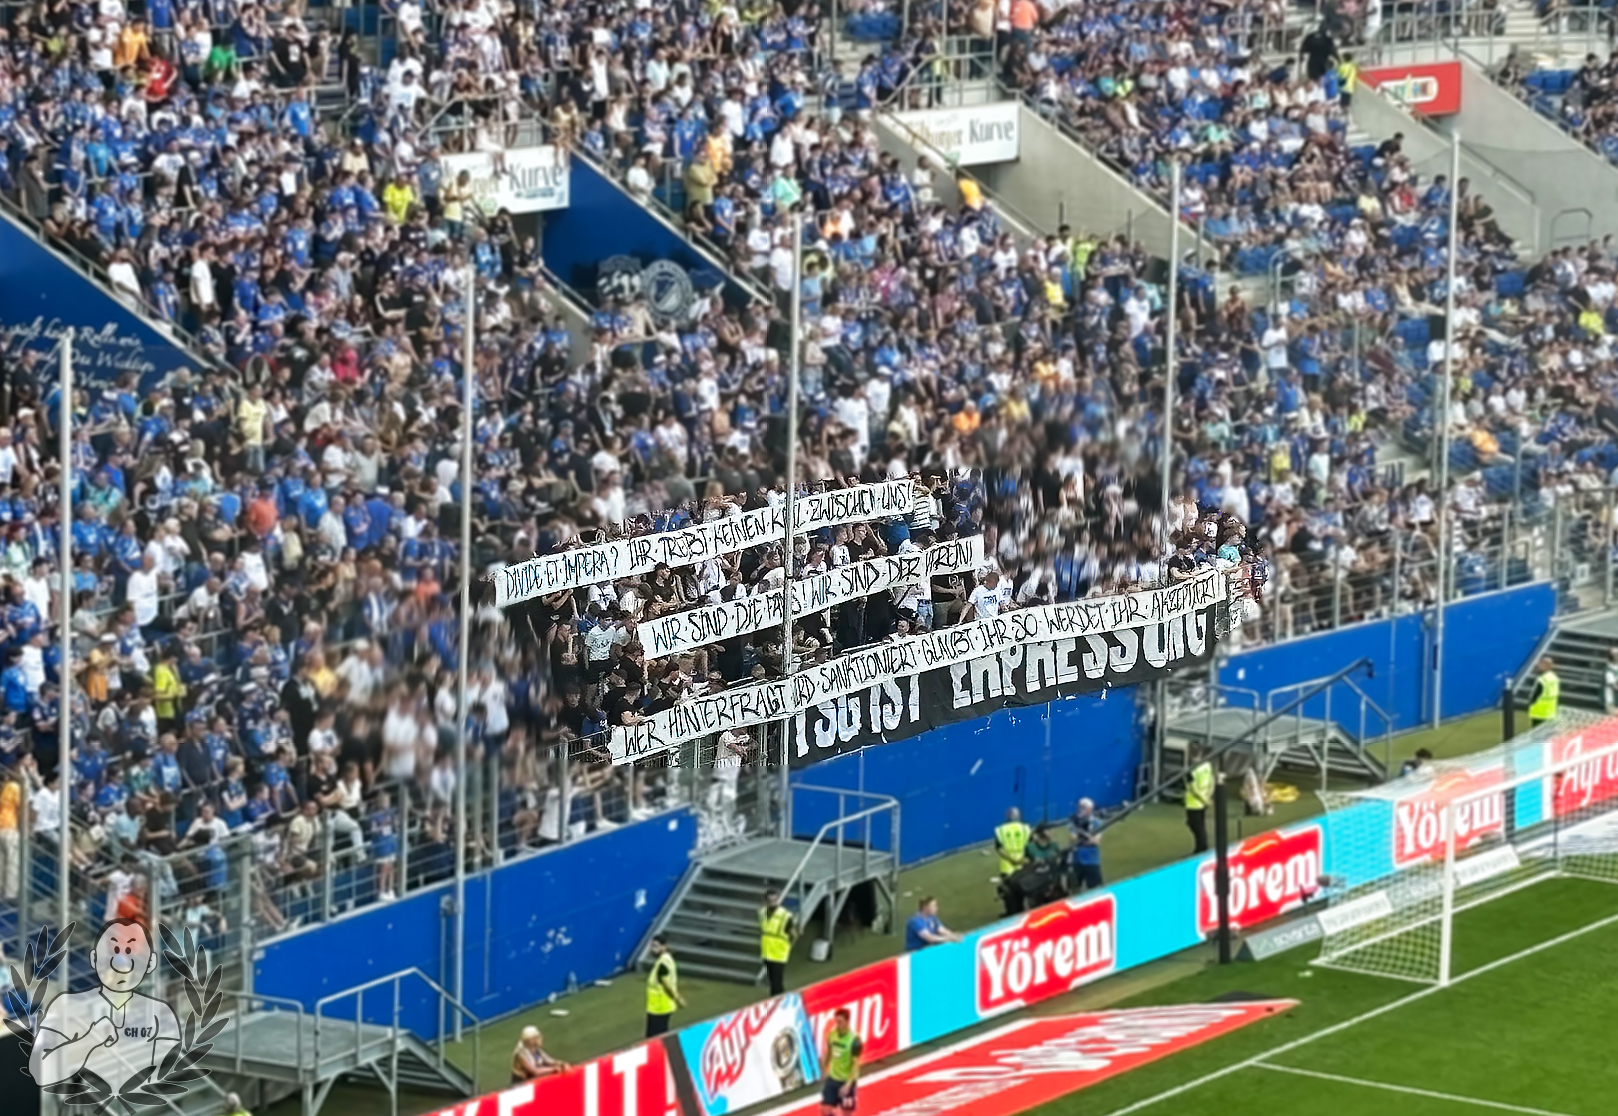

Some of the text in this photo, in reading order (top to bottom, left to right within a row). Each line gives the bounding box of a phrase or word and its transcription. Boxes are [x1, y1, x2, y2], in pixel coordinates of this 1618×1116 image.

[505, 563, 543, 600] DIVIDE
[546, 560, 559, 588] ET
[562, 546, 619, 585] IMPERA?
[627, 539, 656, 571] IHR
[714, 511, 766, 554] KEINEN
[809, 488, 875, 521] ZWISCHEN
[882, 481, 911, 511] UNS!
[652, 616, 686, 654] WIR
[688, 606, 728, 642] SIND
[734, 599, 763, 633] DIE
[766, 584, 808, 620] FAS!
[811, 574, 837, 609] WIR
[841, 562, 879, 596] SIND
[886, 556, 920, 584] DER
[623, 718, 665, 756] WER
[668, 684, 786, 738] HINTERFRAGT
[820, 641, 918, 693] SANKTIONIERT
[922, 627, 975, 666] GLAUBT
[977, 618, 1011, 652] IHR
[1012, 613, 1037, 642] SO
[1043, 602, 1106, 635] WERDET
[1111, 592, 1148, 629] IHR
[981, 920, 1111, 1002] Yörem
